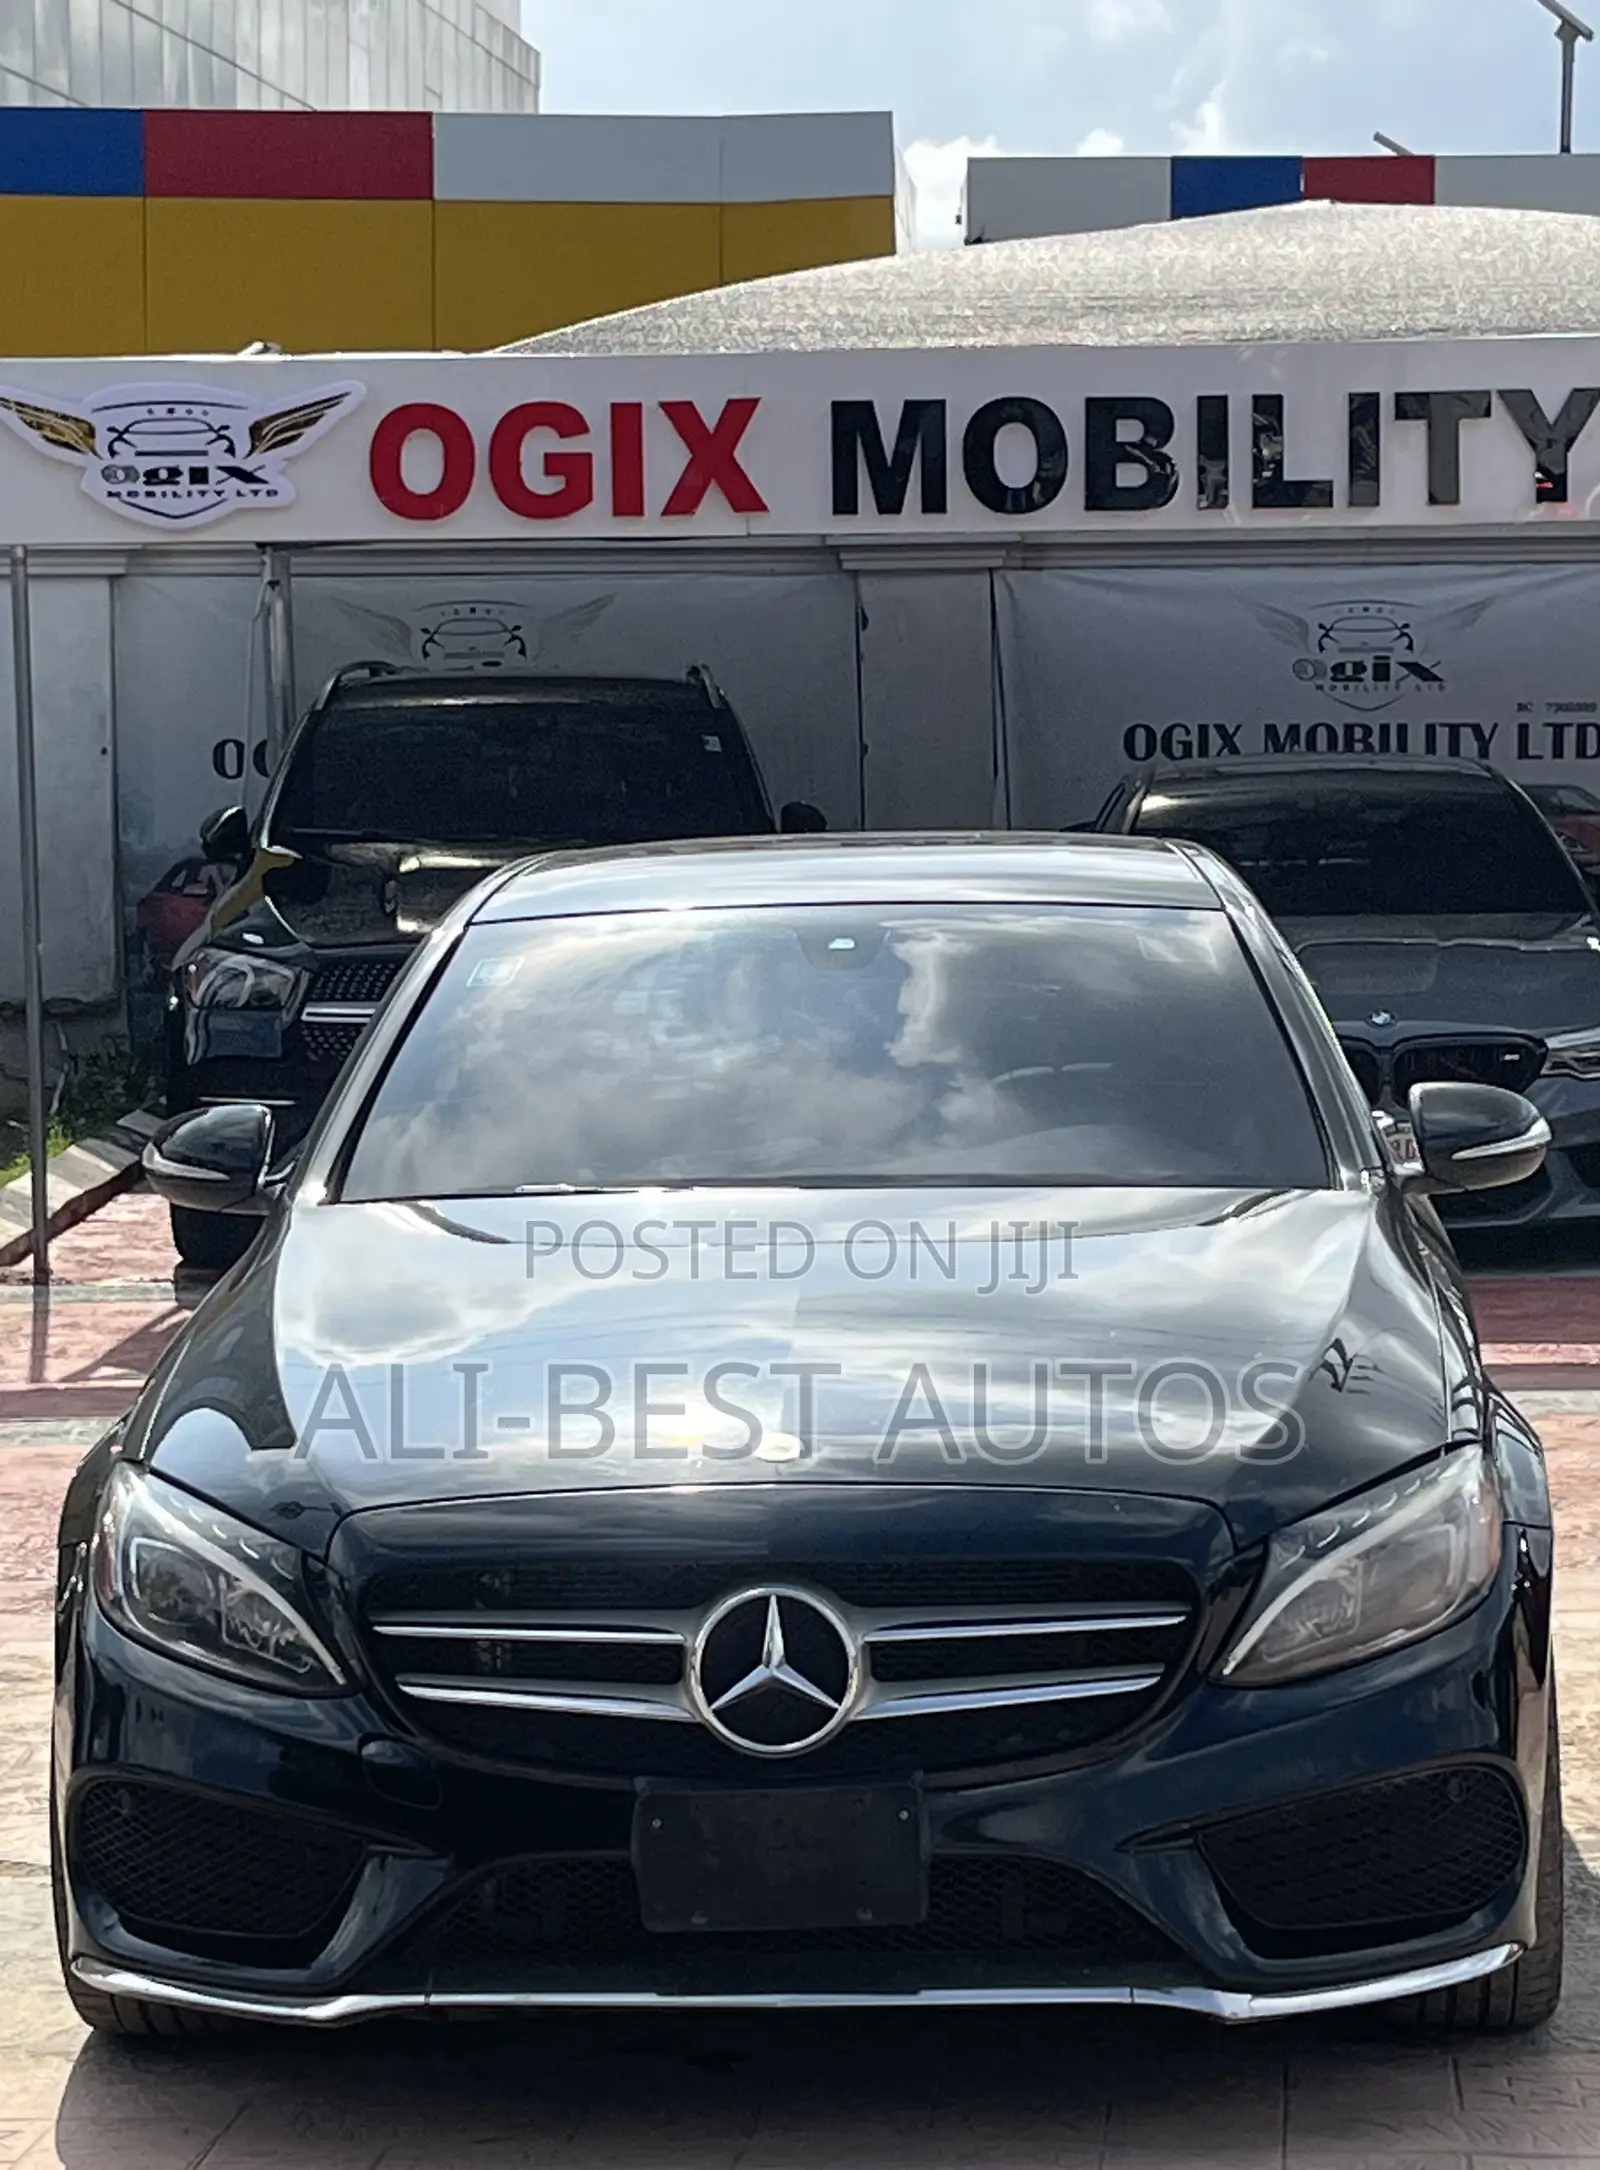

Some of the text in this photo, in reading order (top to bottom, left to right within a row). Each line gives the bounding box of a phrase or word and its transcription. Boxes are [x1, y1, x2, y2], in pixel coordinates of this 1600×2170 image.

[369, 388, 1600, 521] OGIX MOBILITY
[1123, 722, 1242, 762] OGIX
[1517, 722, 1600, 760] LTD
